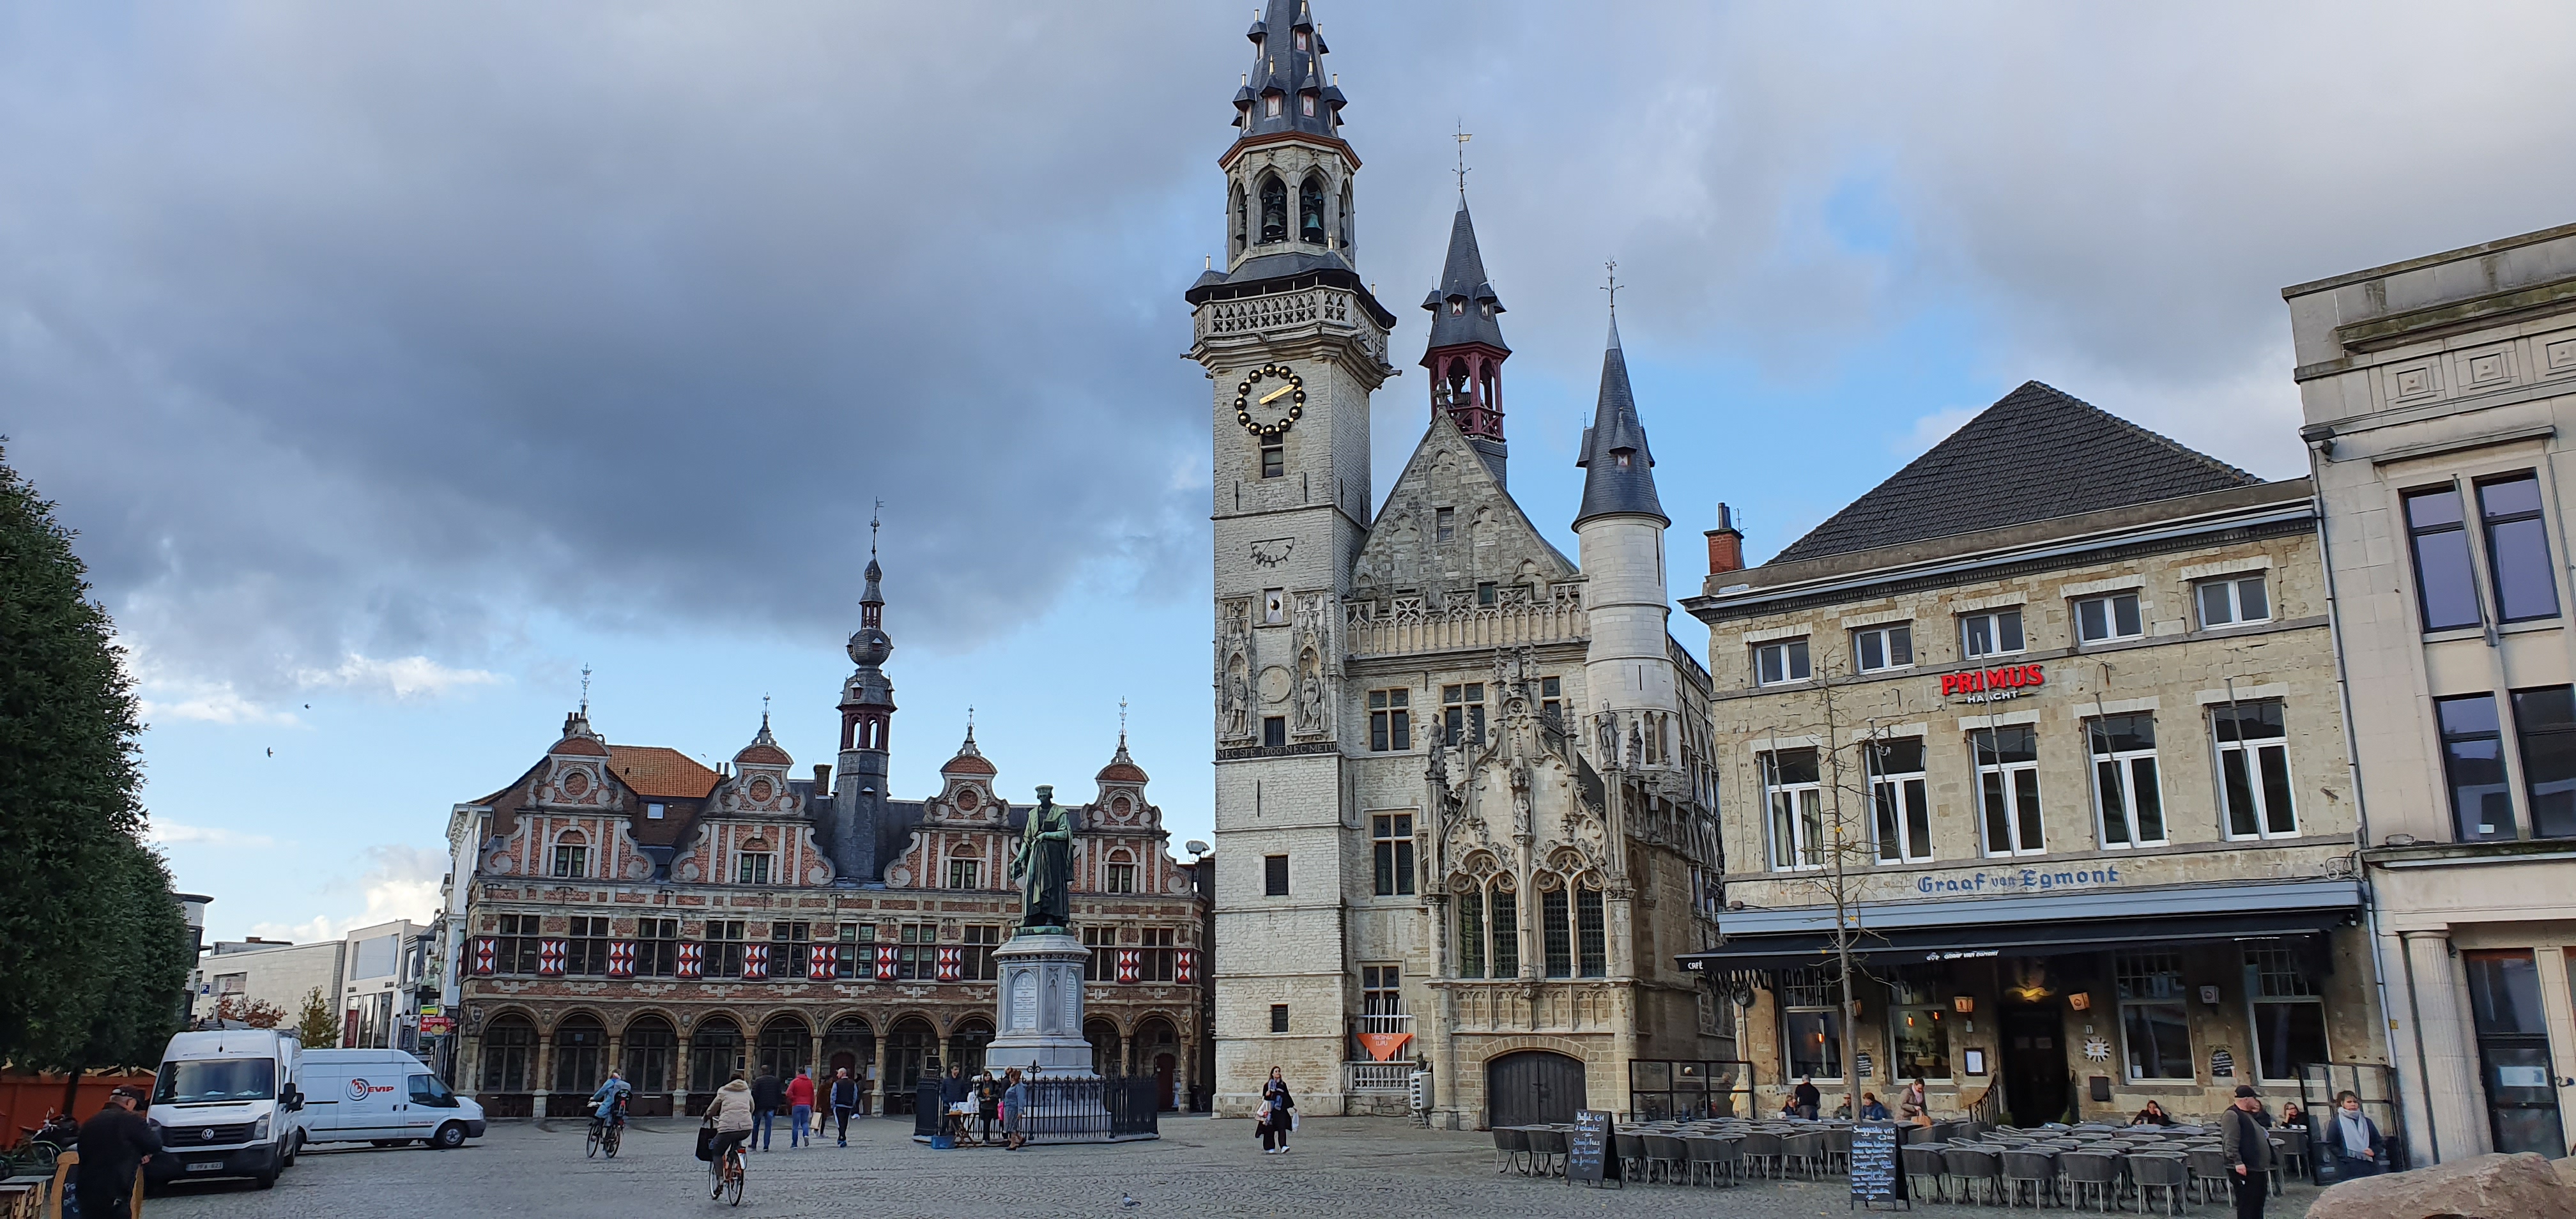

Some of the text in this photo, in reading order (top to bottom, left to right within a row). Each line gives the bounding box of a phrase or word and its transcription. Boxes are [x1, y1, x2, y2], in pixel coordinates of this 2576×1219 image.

[1940, 664, 2044, 696] PRIMUS
[1217, 749, 1238, 759] NEC
[1239, 747, 1256, 758] SPE
[1285, 744, 1307, 755] NEC
[1309, 742, 1336, 753] METU
[1917, 866, 2120, 893] Graaf van Egmont
